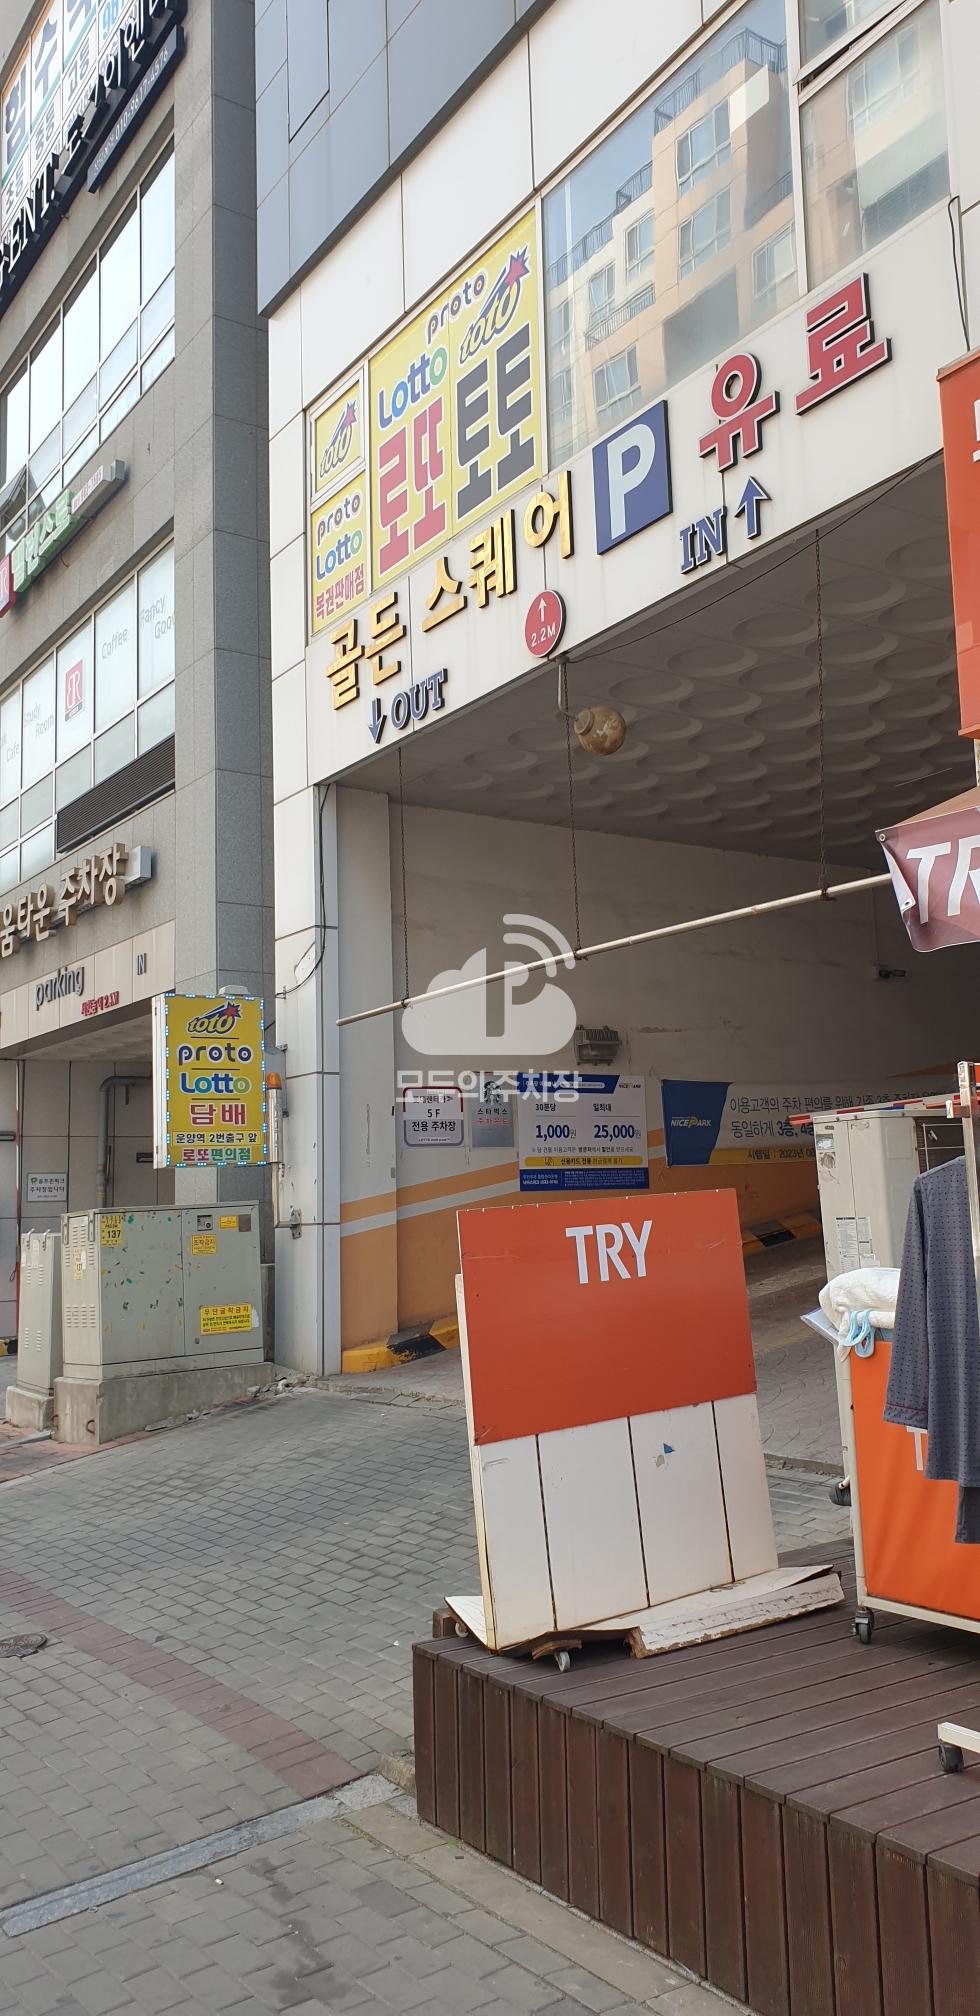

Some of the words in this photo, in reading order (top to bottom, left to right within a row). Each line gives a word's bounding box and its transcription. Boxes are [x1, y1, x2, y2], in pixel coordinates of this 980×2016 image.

[428, 275, 485, 344] proto
[460, 260, 522, 364] toto
[379, 348, 448, 429] Lotto
[698, 272, 892, 473] 유료
[320, 412, 354, 478] toto
[379, 396, 446, 577] 로또
[456, 323, 535, 520] 토토
[607, 423, 656, 540] P
[317, 491, 361, 546] proto
[679, 506, 727, 574] IN
[316, 528, 362, 580] Lotto
[316, 562, 364, 620] 복권판매점
[326, 592, 406, 710] 골든
[422, 470, 574, 633] 스퀘어
[102, 628, 128, 659] Coffee
[531, 623, 556, 647] 2.2M
[391, 668, 447, 730] OUT
[58, 843, 121, 927] 주차장
[137, 953, 147, 976] IN
[36, 966, 85, 1011] parking
[187, 1009, 238, 1035] toto
[178, 1043, 252, 1066] proto
[180, 1073, 251, 1094] Lotto
[730, 1097, 780, 1114] 이용고객의
[782, 1098, 801, 1113] 주차
[804, 1096, 832, 1111] 편의를
[190, 1103, 246, 1125] 담배
[412, 1121, 428, 1132] 전용
[431, 1121, 456, 1132] 주차장
[535, 1103, 556, 1112] 30분당
[731, 1120, 774, 1138] 동일하게
[176, 1133, 205, 1144] 운양역
[209, 1133, 244, 1144] 2번출구
[248, 1132, 257, 1143] 앞
[183, 1147, 251, 1162] 로또편의점
[107, 1230, 121, 1239] 137
[565, 1220, 653, 1284] TRY
